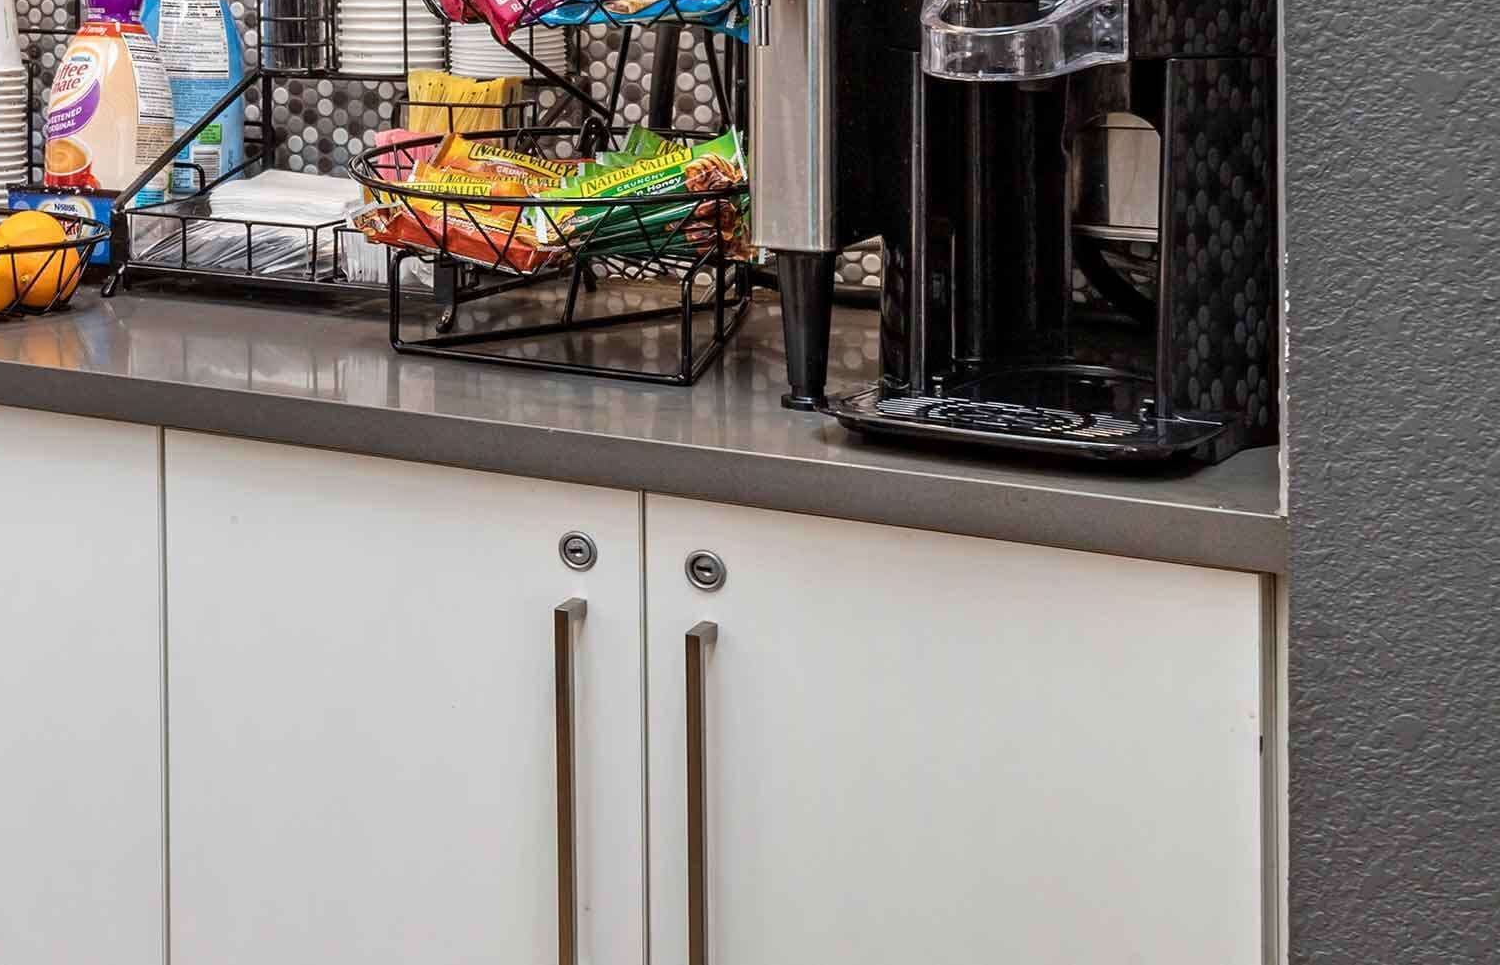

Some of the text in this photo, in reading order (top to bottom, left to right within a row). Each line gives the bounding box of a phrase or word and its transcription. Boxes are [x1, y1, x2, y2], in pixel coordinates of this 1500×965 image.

[474, 143, 574, 178] NATURE VALLEY
[586, 149, 688, 194] NATURE VALLEY
[616, 171, 666, 193] CRUNCHY
[648, 175, 682, 193] Honey
